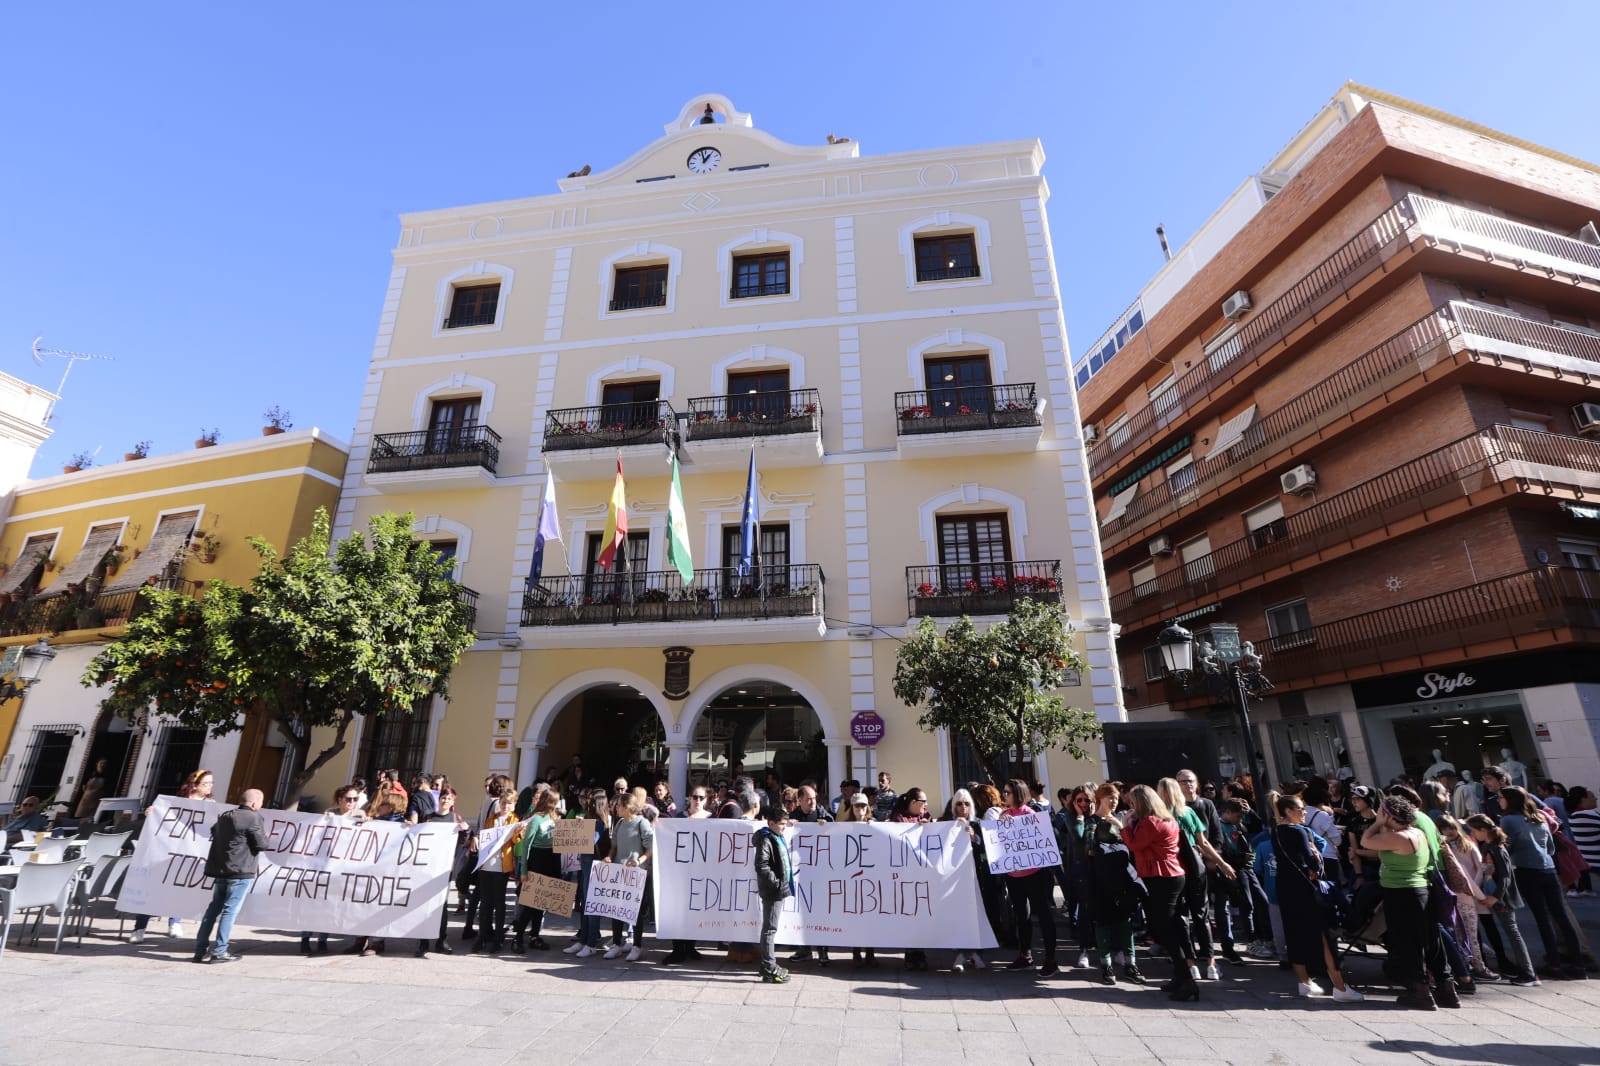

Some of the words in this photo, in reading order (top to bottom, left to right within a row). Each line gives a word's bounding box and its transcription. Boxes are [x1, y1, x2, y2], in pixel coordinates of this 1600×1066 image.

[1416, 672, 1477, 698] Style
[854, 724, 881, 732] STOP
[997, 818, 1014, 830] POR
[1021, 814, 1039, 826] UNA
[155, 807, 205, 841] POR
[265, 819, 390, 864] EDUCACIÓN
[397, 832, 434, 866] DE
[990, 826, 1042, 844] ESCUELA
[675, 831, 708, 863] EN
[718, 831, 833, 870] DEFSA
[845, 834, 875, 868] DE
[888, 833, 945, 873] UNA
[1004, 851, 1058, 871] CALIDAD
[162, 852, 216, 890] TOD
[250, 863, 273, 894] Y
[269, 866, 331, 900] PARA
[341, 872, 411, 907] TODOS
[591, 864, 609, 883] NO
[594, 887, 632, 901] DECRETO
[689, 868, 812, 913] EDUCAÓN
[828, 869, 932, 916] PÚBLICA
